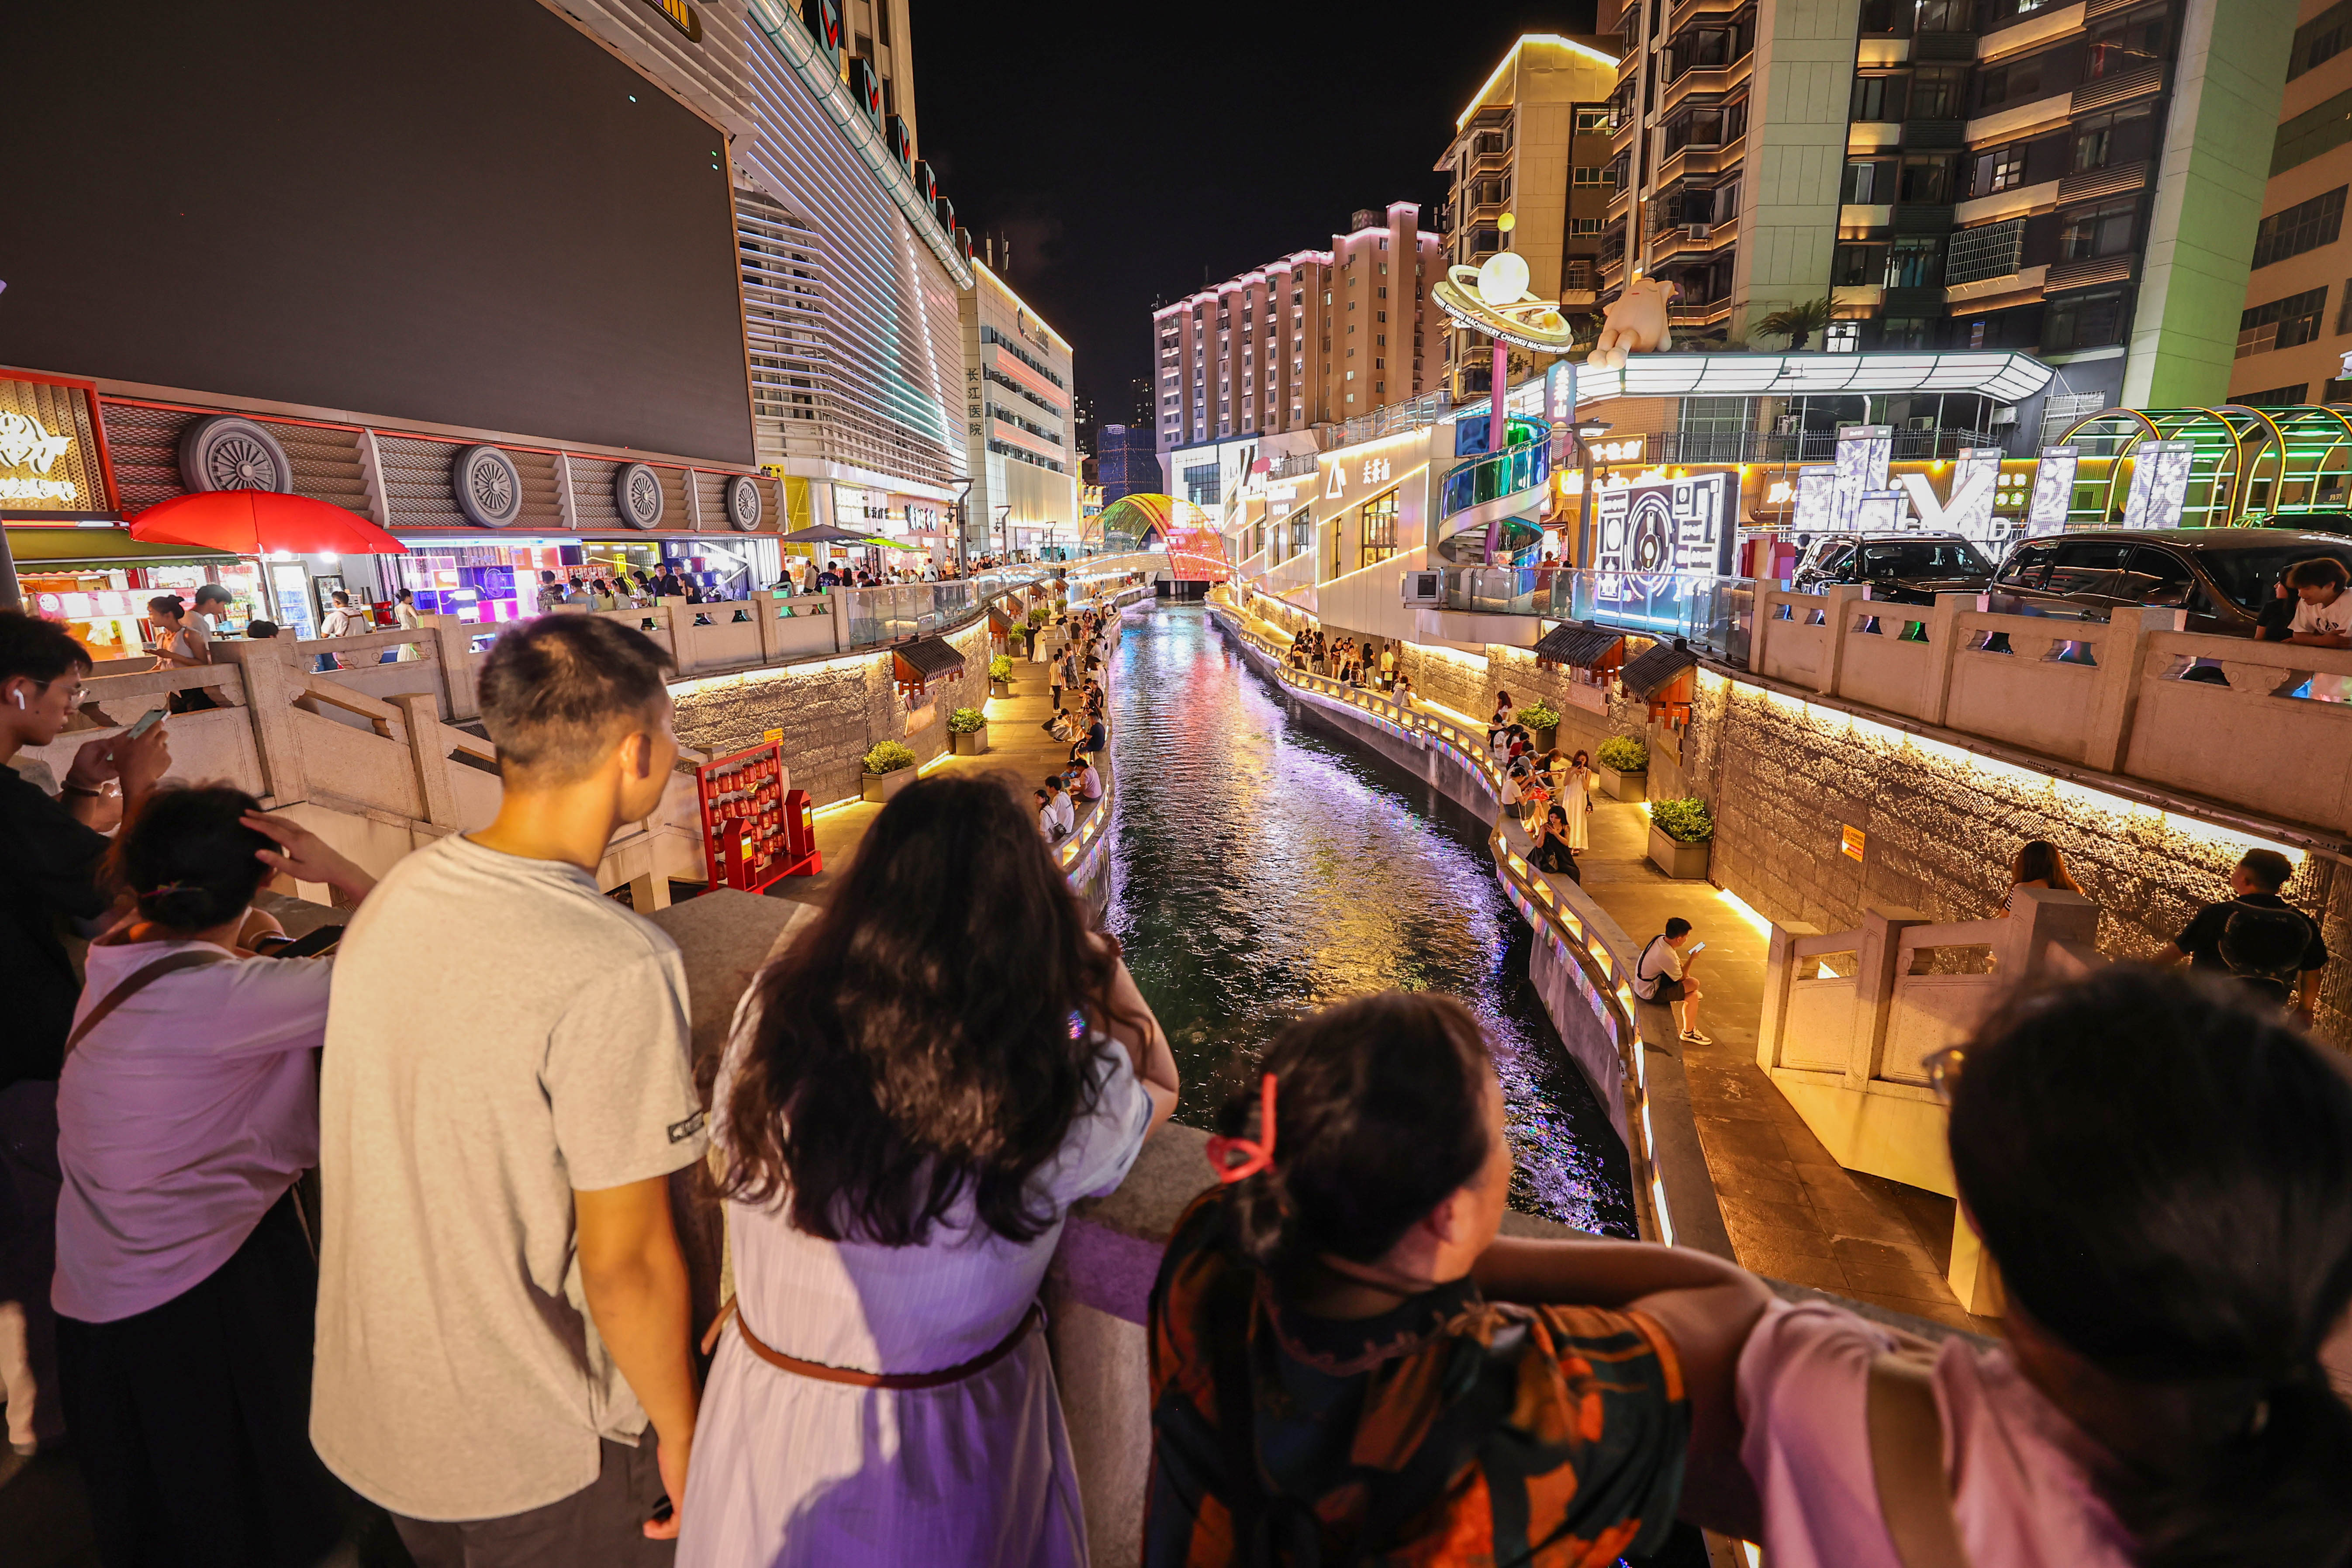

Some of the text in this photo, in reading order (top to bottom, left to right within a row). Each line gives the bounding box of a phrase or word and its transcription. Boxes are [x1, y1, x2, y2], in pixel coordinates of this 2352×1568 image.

[1445, 304, 1466, 320] CHAOKU
[1464, 316, 1501, 337] MACHINERY
[1501, 333, 1528, 347] CHAOKU
[966, 368, 982, 435] 长江医院
